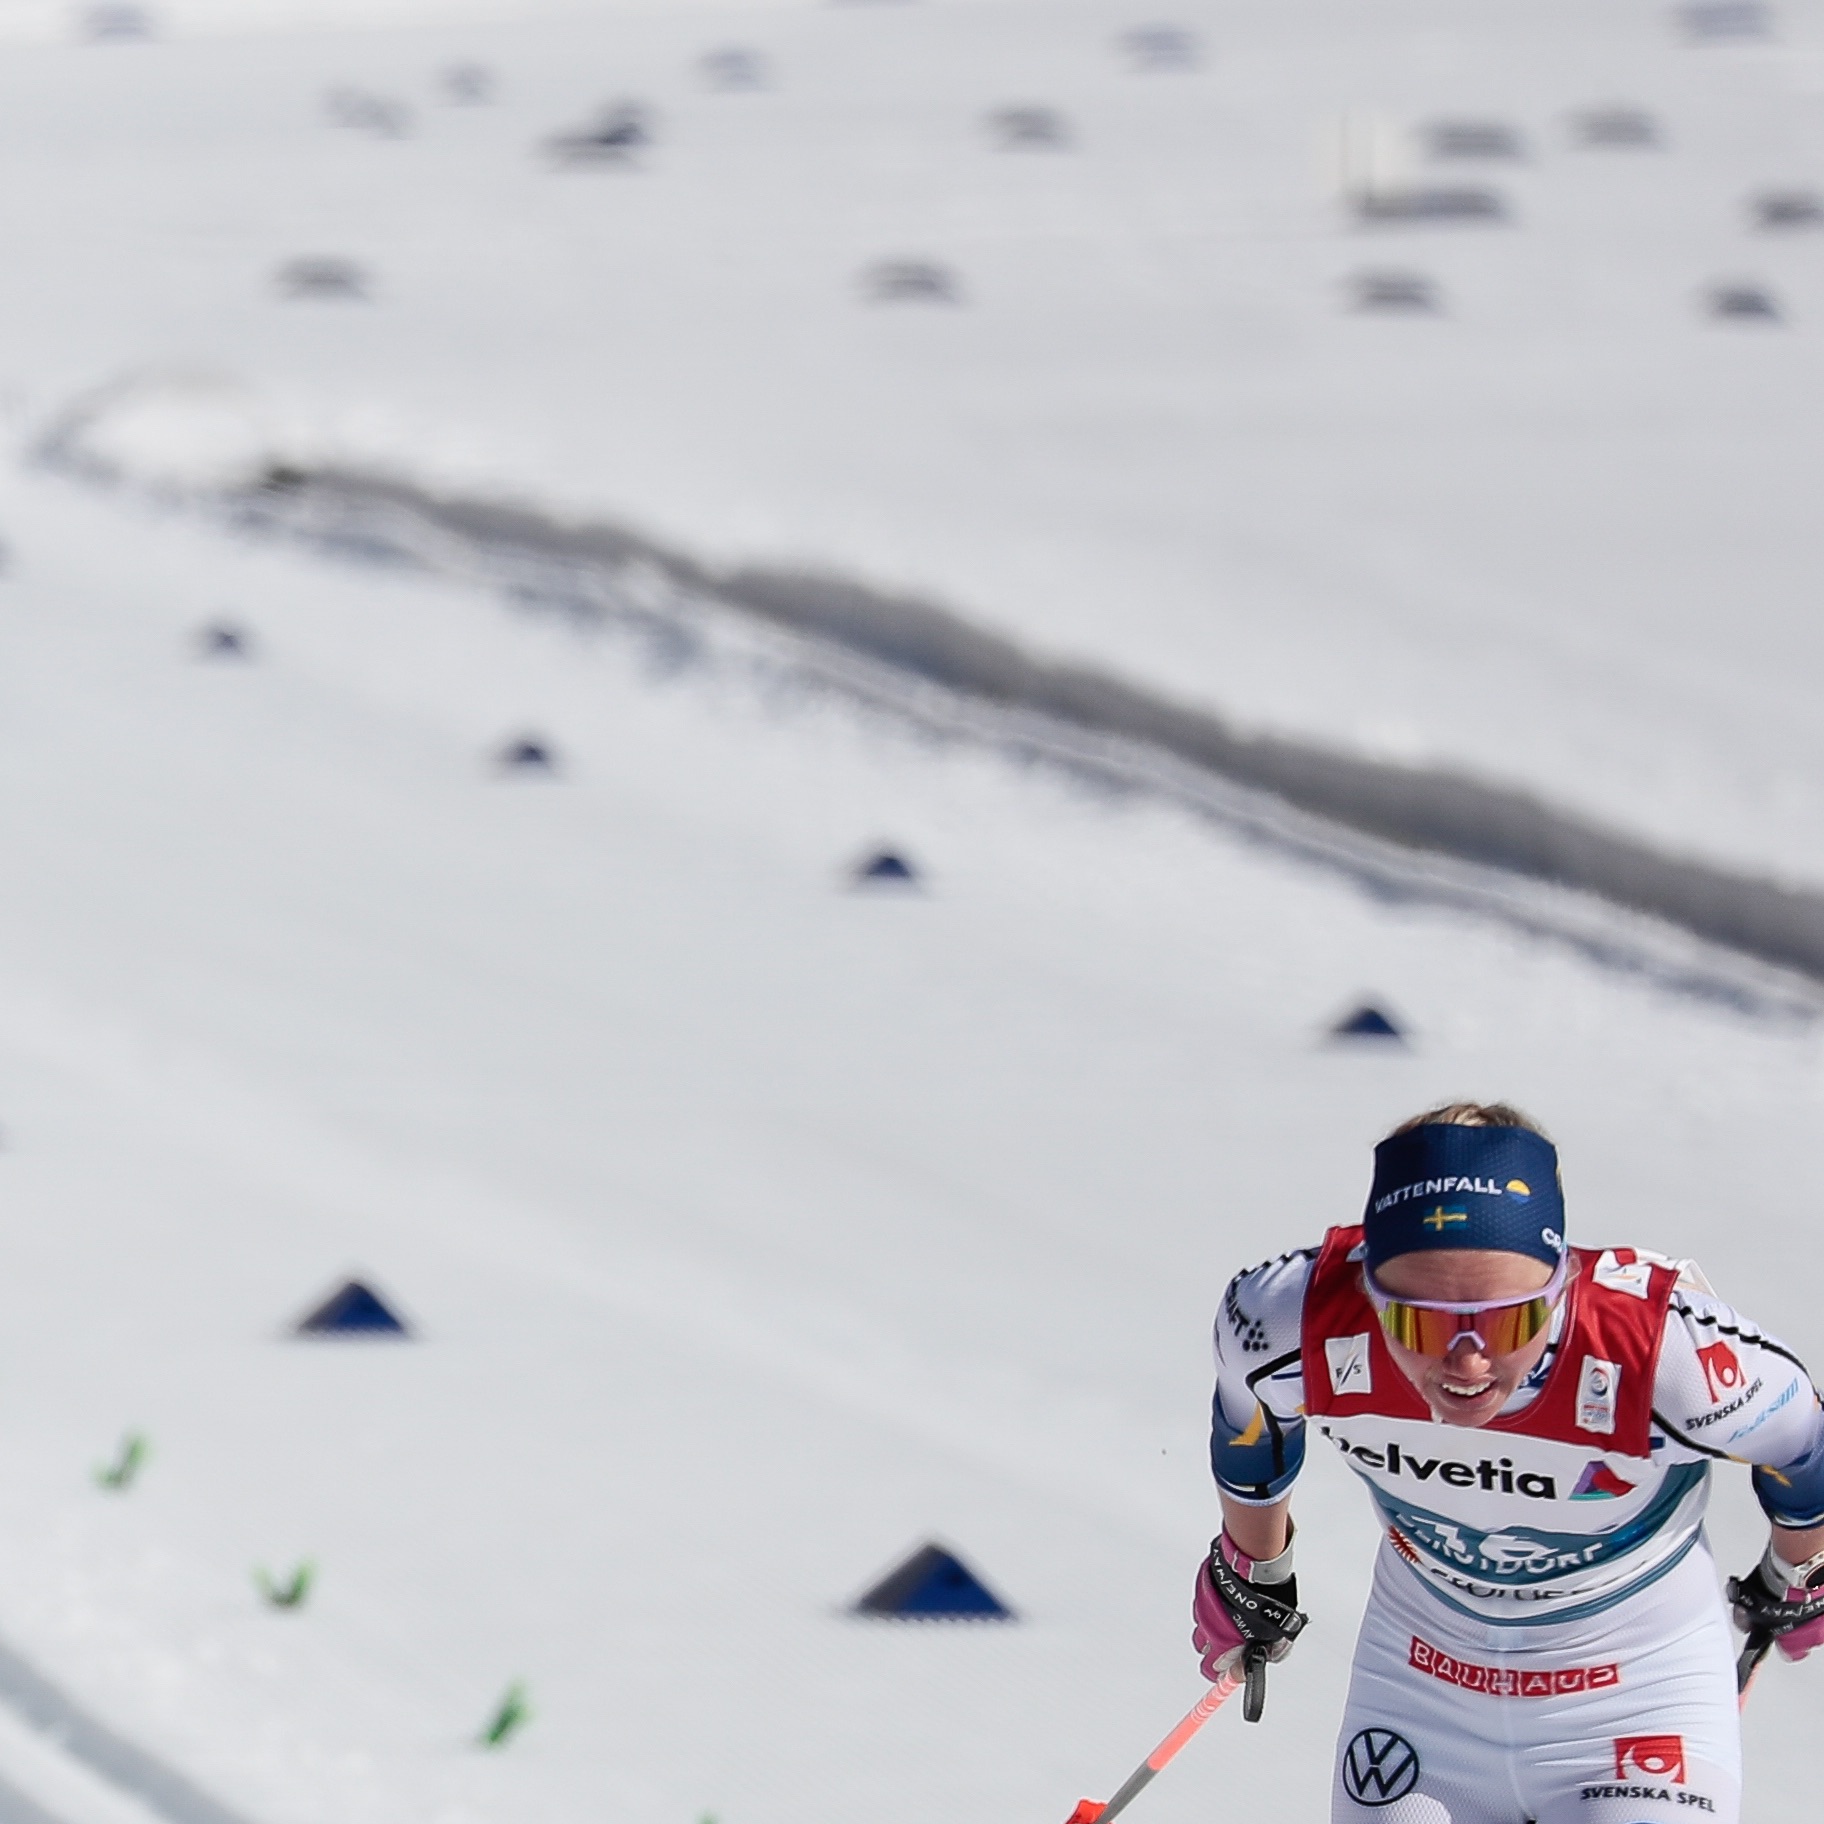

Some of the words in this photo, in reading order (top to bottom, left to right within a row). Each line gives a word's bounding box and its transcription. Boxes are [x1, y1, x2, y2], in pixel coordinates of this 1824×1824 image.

[1374, 1176, 1502, 1214] VATTENFALL
[1685, 1399, 1744, 1432] SVENSKA
[1581, 1786, 1670, 1801] SVENSKA
[1677, 1791, 1716, 1813] SPEL
